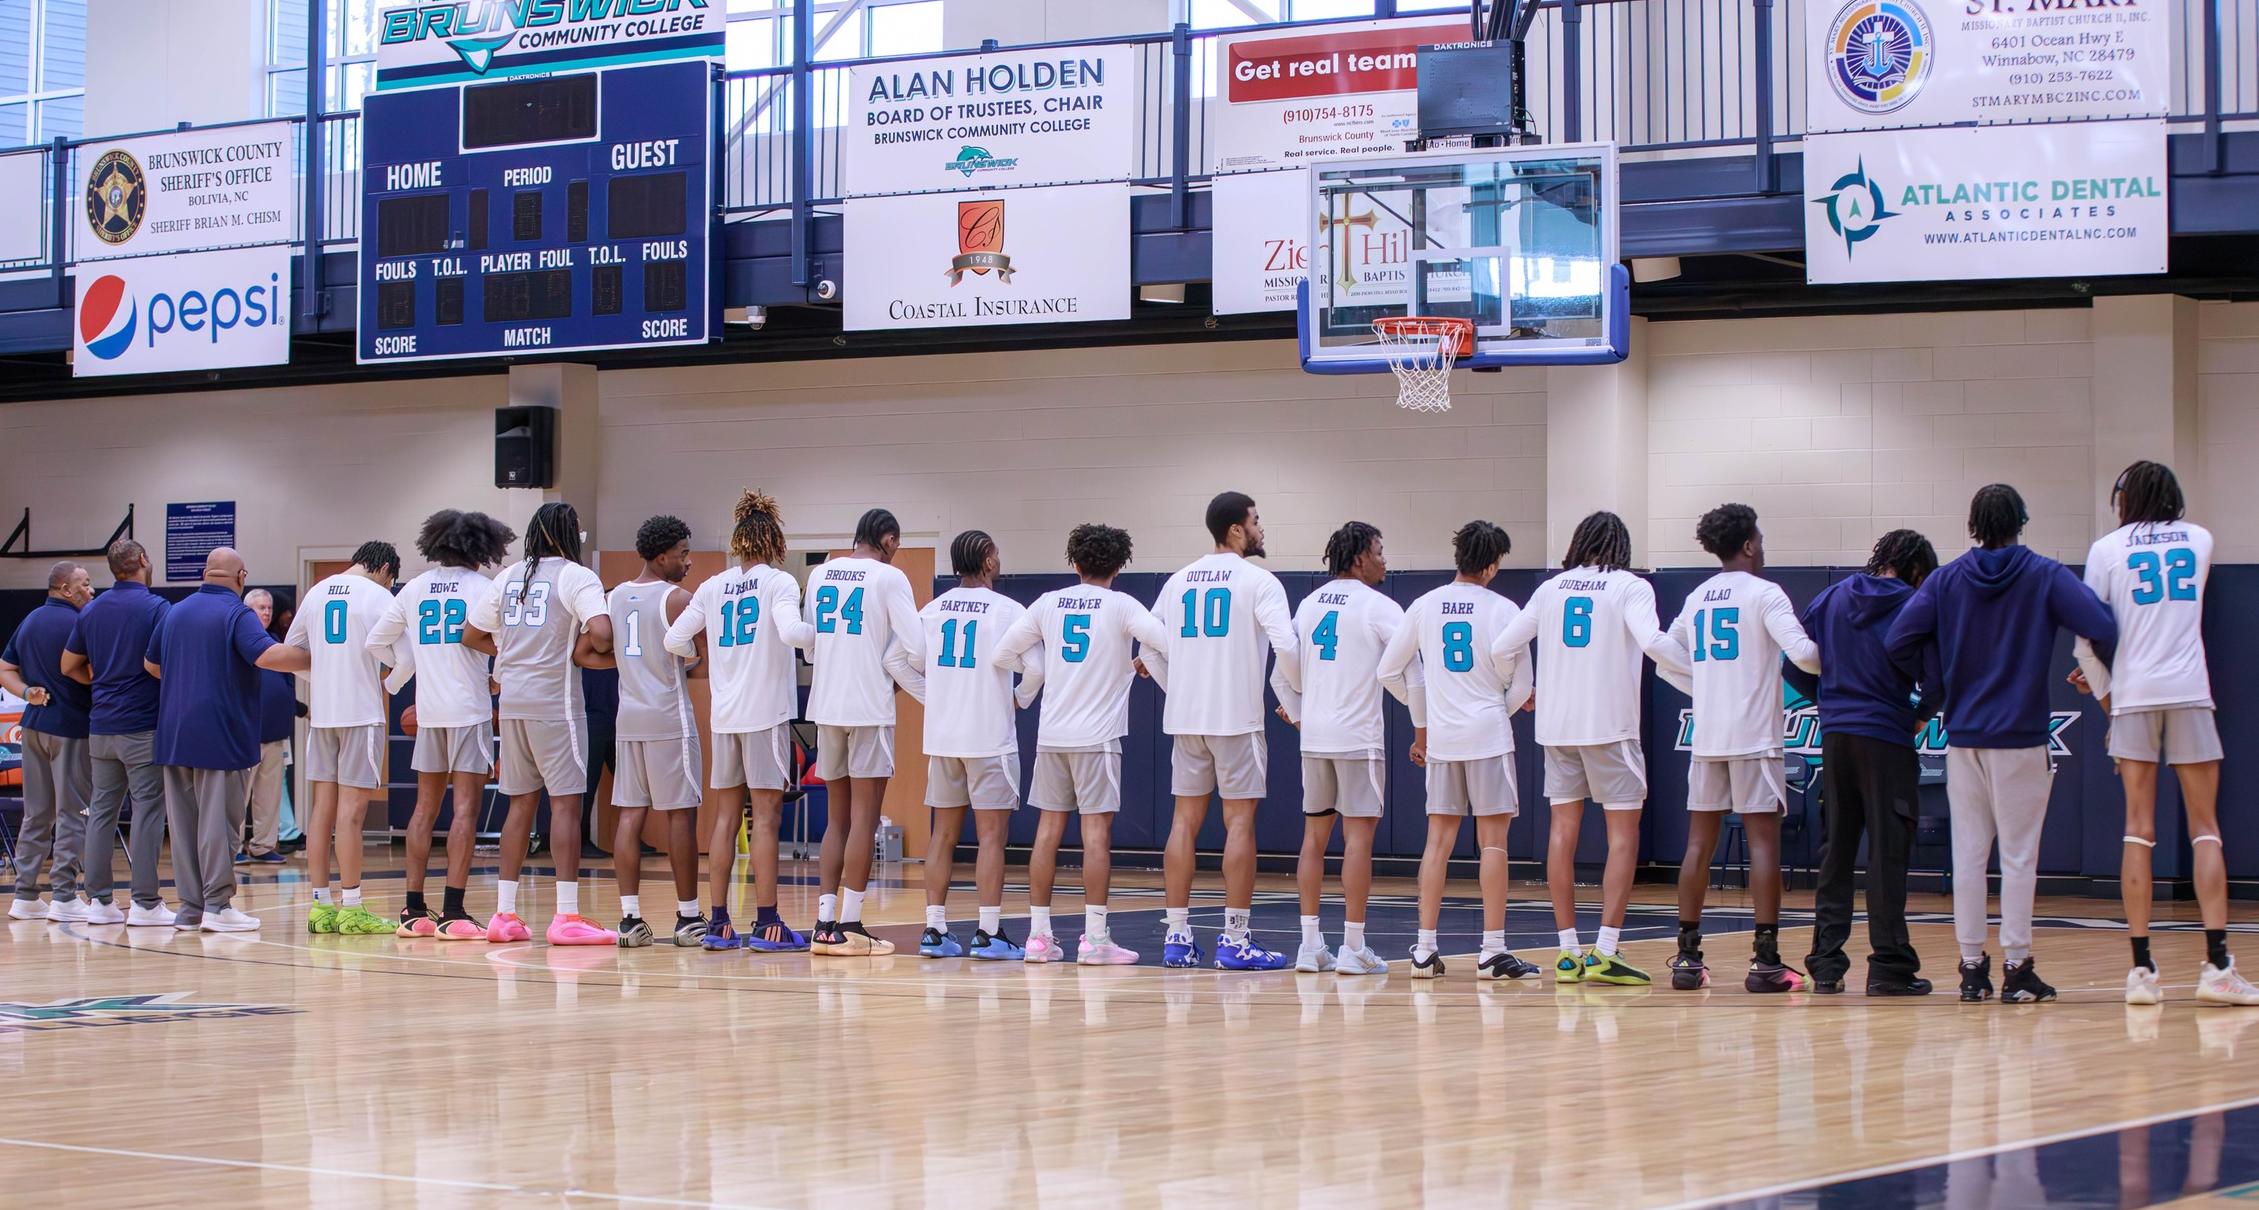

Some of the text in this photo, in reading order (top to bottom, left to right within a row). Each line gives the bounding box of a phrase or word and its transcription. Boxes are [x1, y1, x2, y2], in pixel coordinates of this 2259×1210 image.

[519, 14, 704, 48] COMMUNITY COLLEGE
[1962, 18, 2022, 31] MISSIOARY
[2026, 16, 2064, 28] BAPTIST
[2068, 13, 2112, 25] CHURCH
[1434, 40, 1492, 50] DAKTRONICS
[1992, 31, 2124, 49] 6401 Ocean Hwy E
[1235, 51, 1416, 82] Get real team
[1982, 48, 2134, 66] Winnabow, NC 28479
[868, 58, 1104, 103] ALAN HOLDEN
[2009, 70, 2112, 86] (910) 253-7622
[1972, 89, 2141, 108] STMARYMBC2INC.COM
[867, 94, 1102, 126] BOARD OF TRUSTEES, CHAIR
[1284, 104, 1374, 124] (910)754-8175
[874, 118, 1090, 144] BRUNSWICK COMMUNITY COLLEGE
[1299, 132, 1342, 144] Brunswick
[1345, 131, 1374, 141] County
[1284, 144, 1394, 158] Real service. Real people.
[1446, 140, 1469, 148] Home
[148, 142, 282, 170] BRUNSWICK COUNTY
[612, 139, 679, 170] GUEST
[160, 166, 272, 192] SHERIFF'S OFFICE
[387, 161, 442, 190] HOME
[504, 166, 552, 186] PERIOD
[188, 191, 248, 206] BOLIVIA, NC
[1901, 176, 2161, 206] ATLANTIC DENTAL
[150, 210, 280, 234] SHERIFF BRIAN M. CHISM
[1946, 205, 2117, 222] ASSOCIATES
[1924, 226, 2138, 245] WWW.ATLANTICDENTALNC.COM
[588, 246, 626, 265] T.O.L.
[642, 240, 688, 261] FOULS
[970, 255, 992, 264] 1948
[1265, 230, 1407, 270] Zi Hil
[376, 260, 416, 280] FOULS
[432, 258, 468, 276] T.O.L.
[481, 249, 574, 273] PLAYER FOUL
[1364, 270, 1406, 282] BAPTIS
[148, 272, 278, 348] pepsi
[889, 296, 1078, 320] COASTAL INSURANCE
[504, 327, 550, 346] MATCH
[642, 318, 688, 338] SCORE
[375, 336, 416, 355] SCORE
[824, 569, 866, 582] BROOKS
[1186, 570, 1232, 582] OUTLAW
[1558, 580, 1608, 590] DURHAM
[2128, 548, 2196, 605] 32
[328, 585, 350, 595] HILL
[430, 582, 460, 594] ROWE
[1704, 588, 1732, 602] ALAO
[504, 580, 551, 627] 33
[940, 600, 990, 614] BARTNEY
[1058, 597, 1102, 610] BREWER
[1318, 594, 1346, 606] KANE
[1442, 602, 1474, 614] BARR
[816, 586, 864, 635] 24
[1181, 588, 1232, 638] 10
[324, 599, 347, 644] 0
[419, 598, 468, 645] 22
[719, 596, 759, 647] 12
[1563, 596, 1594, 648] 6
[624, 610, 643, 656] 1
[938, 618, 977, 668] 11
[1062, 614, 1090, 662] 5
[1312, 610, 1338, 661] 4
[1694, 607, 1739, 662] 15
[1442, 621, 1473, 672] 8
